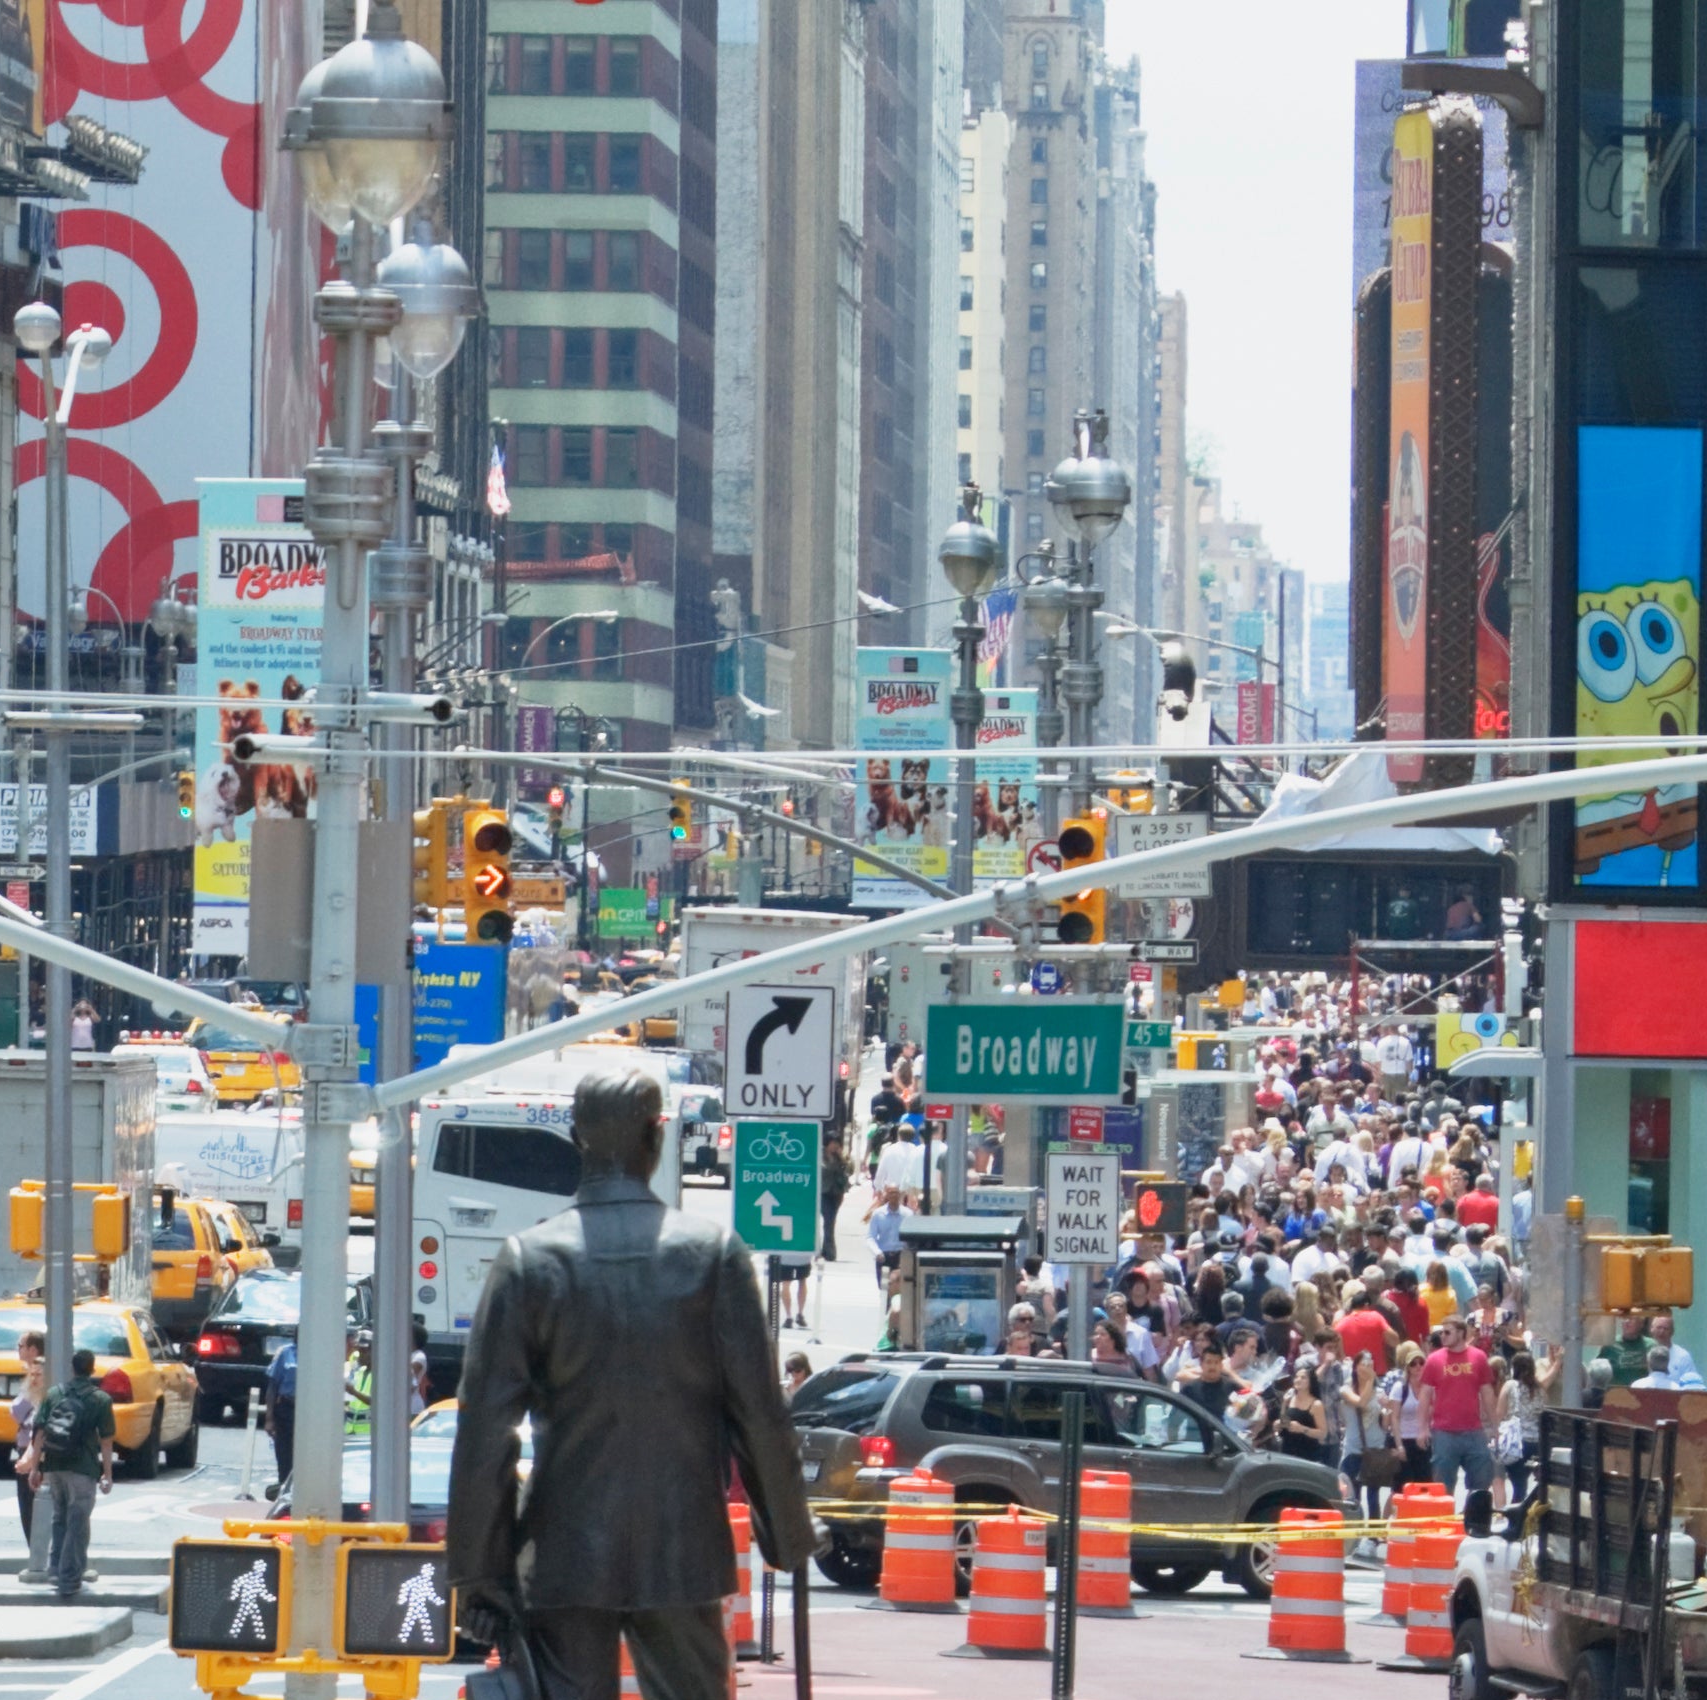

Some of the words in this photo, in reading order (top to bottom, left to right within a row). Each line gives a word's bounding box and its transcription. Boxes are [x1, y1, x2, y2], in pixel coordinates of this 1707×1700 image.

[240, 627, 293, 640] BROADWAY
[868, 684, 938, 703] BROADWAY
[1131, 824, 1143, 835] W
[1149, 824, 1169, 834] 39
[1176, 822, 1194, 834] ST
[199, 918, 233, 930] ASPCA
[1166, 947, 1189, 956] WAY
[458, 970, 482, 987] NY
[1134, 1025, 1152, 1045] 45
[1157, 1026, 1169, 1036] ST
[956, 1025, 1098, 1088] Broadway
[742, 1083, 815, 1108] ONLY
[527, 1108, 574, 1124] 3858
[742, 1169, 812, 1187] Broadway
[1062, 1166, 1105, 1183] WAIT
[1066, 1190, 1100, 1207] FOR
[1057, 1213, 1108, 1230] WALK
[1054, 1237, 1109, 1255] SIGNAL
